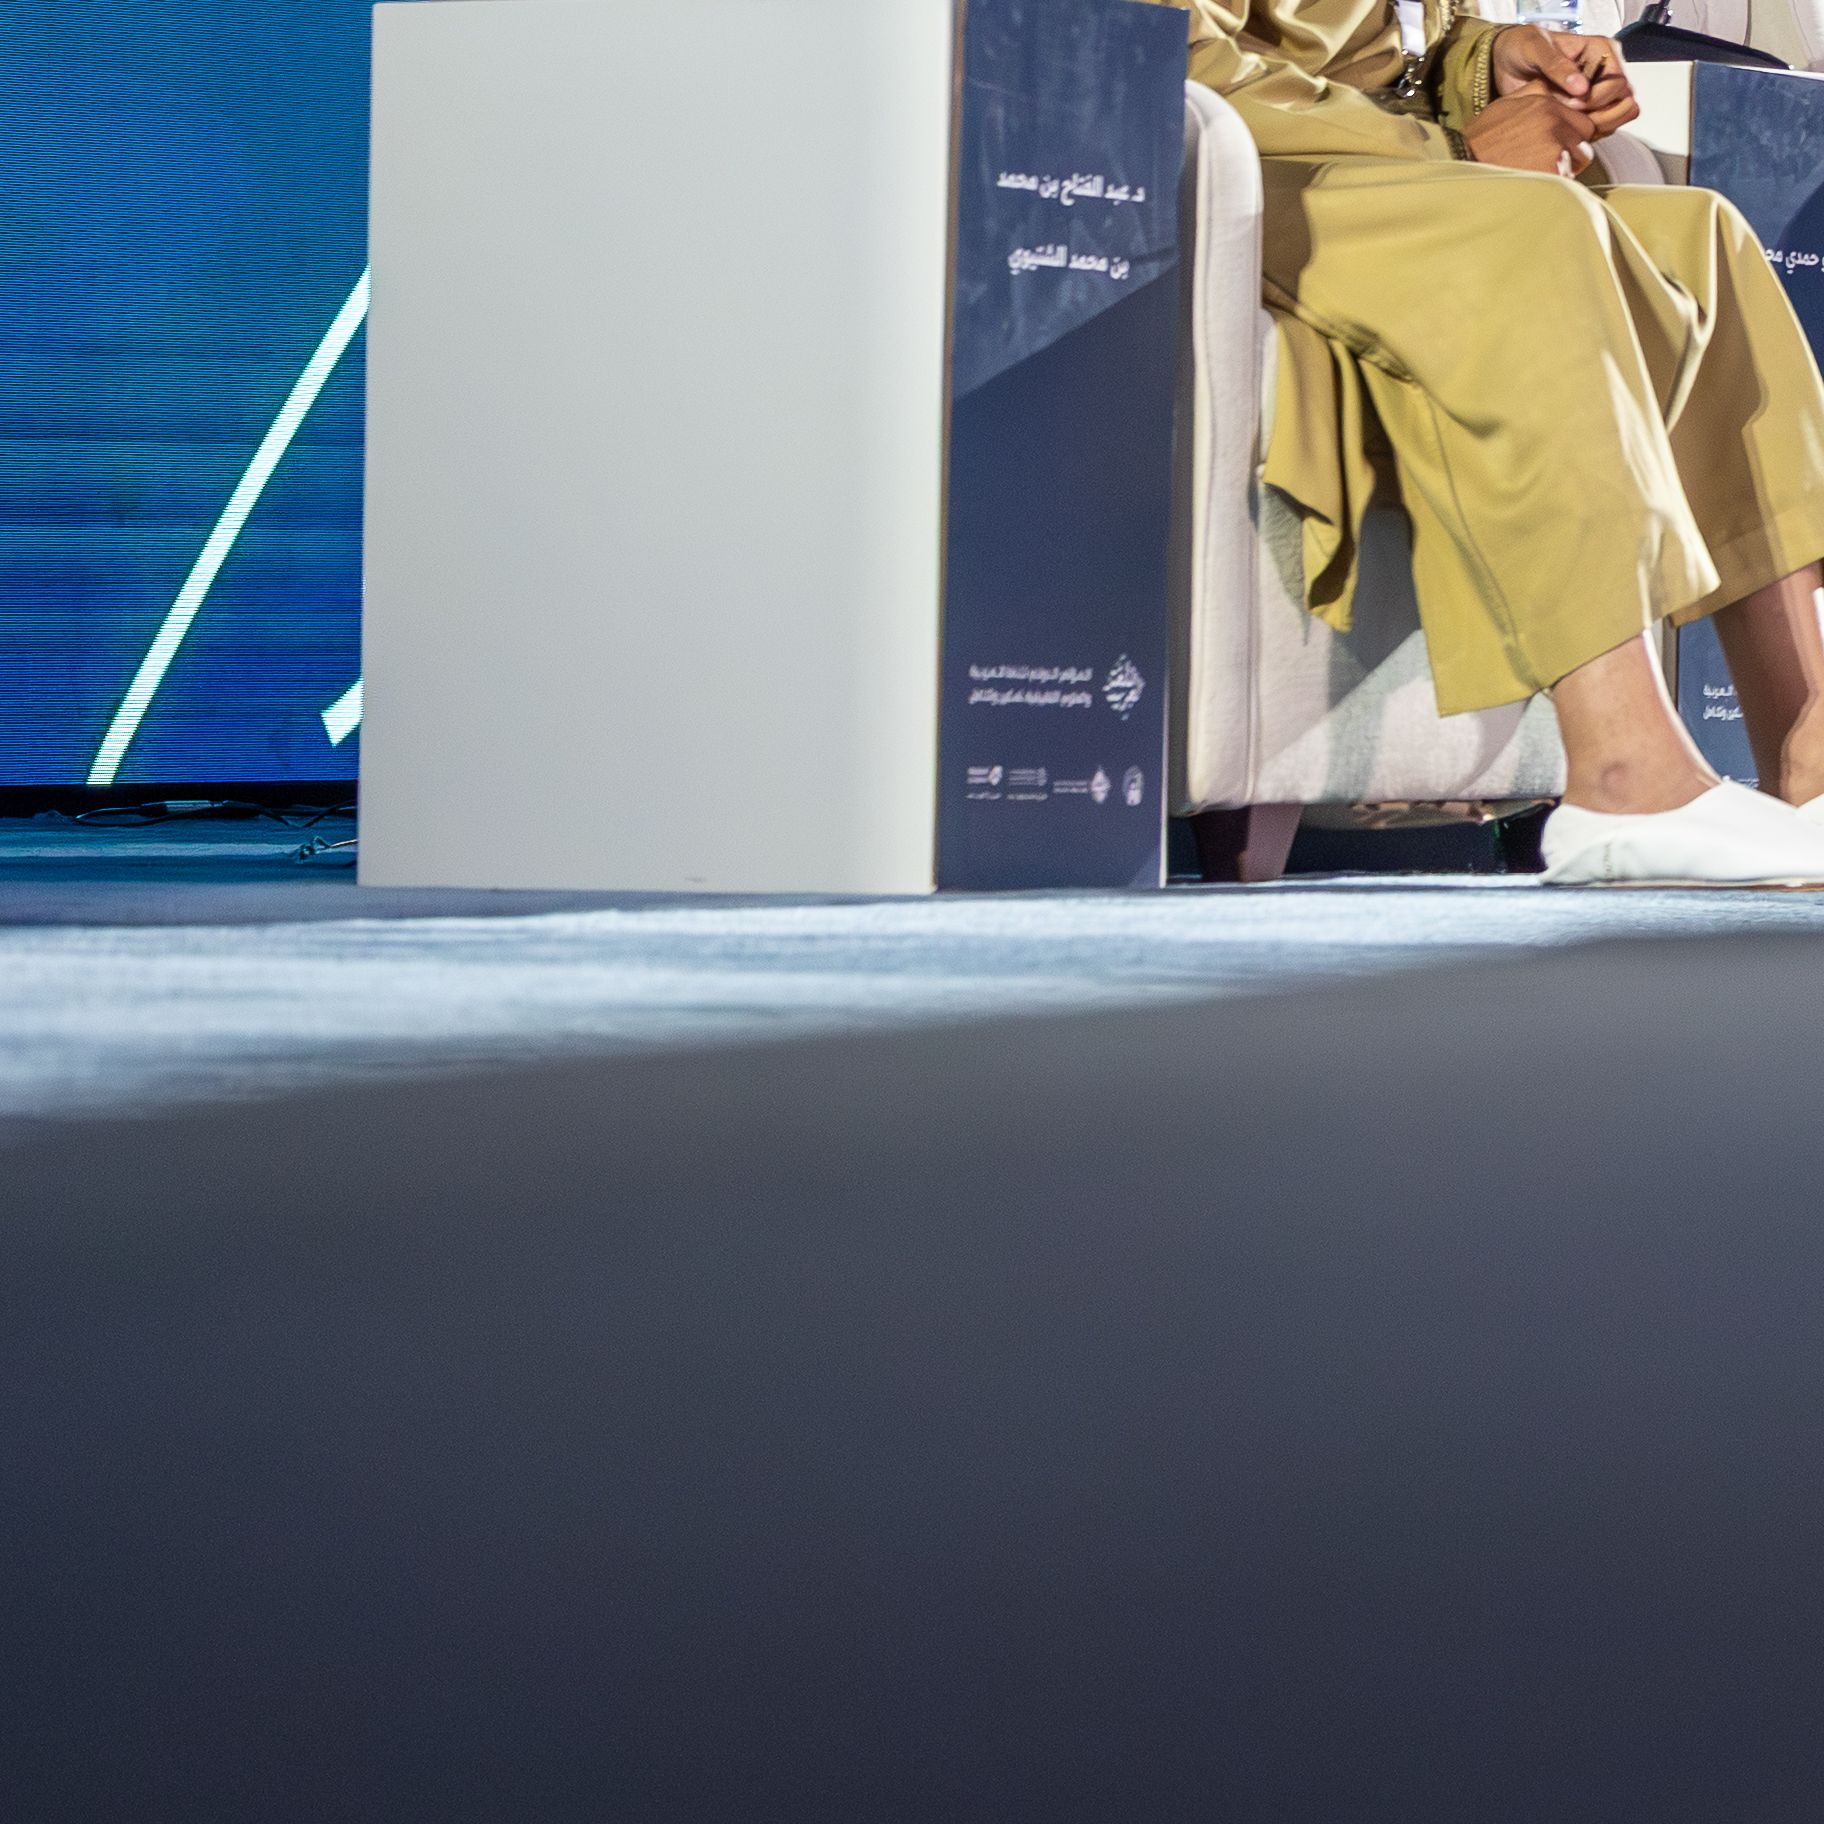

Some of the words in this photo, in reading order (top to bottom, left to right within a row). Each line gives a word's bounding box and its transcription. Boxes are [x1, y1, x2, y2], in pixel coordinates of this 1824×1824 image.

[997, 171, 1039, 191] محمد
[1039, 174, 1059, 199] بن
[1068, 254, 1109, 272] محمد
[1764, 249, 1783, 263] مح
[1785, 252, 1820, 274] حمدي
